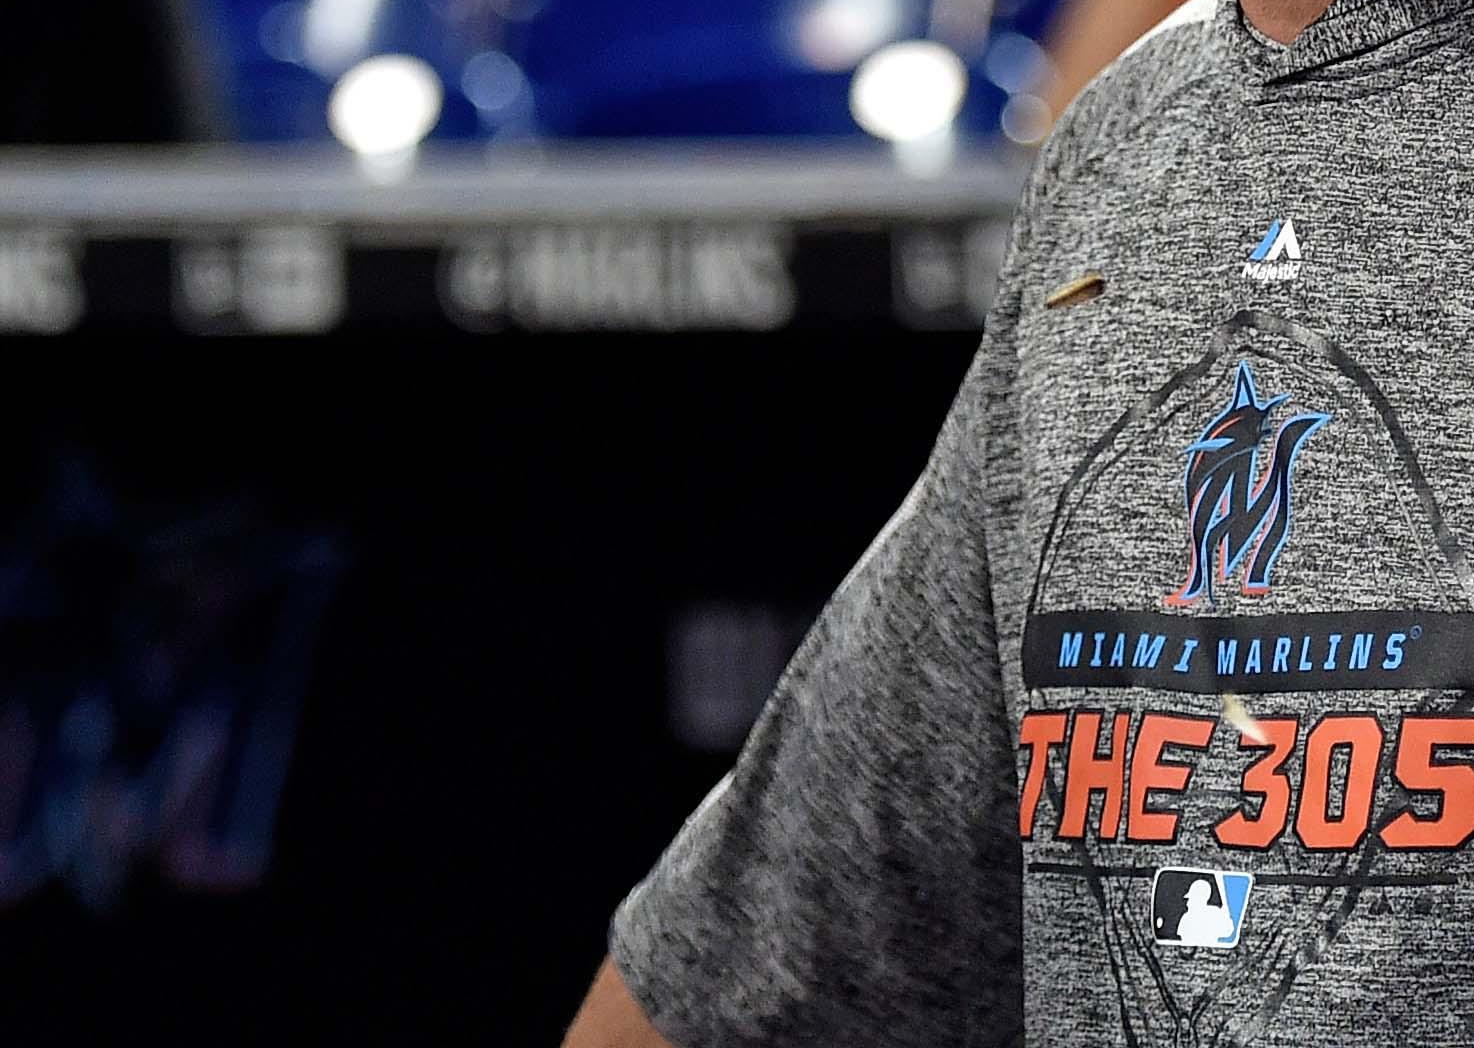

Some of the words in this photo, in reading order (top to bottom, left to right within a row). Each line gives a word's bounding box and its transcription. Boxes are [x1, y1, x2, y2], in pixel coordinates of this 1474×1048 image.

[1241, 261, 1301, 284] Majestic
[1059, 632, 1199, 672] MIAMI
[1217, 632, 1407, 675] MARLINS
[1018, 711, 1217, 840] THE
